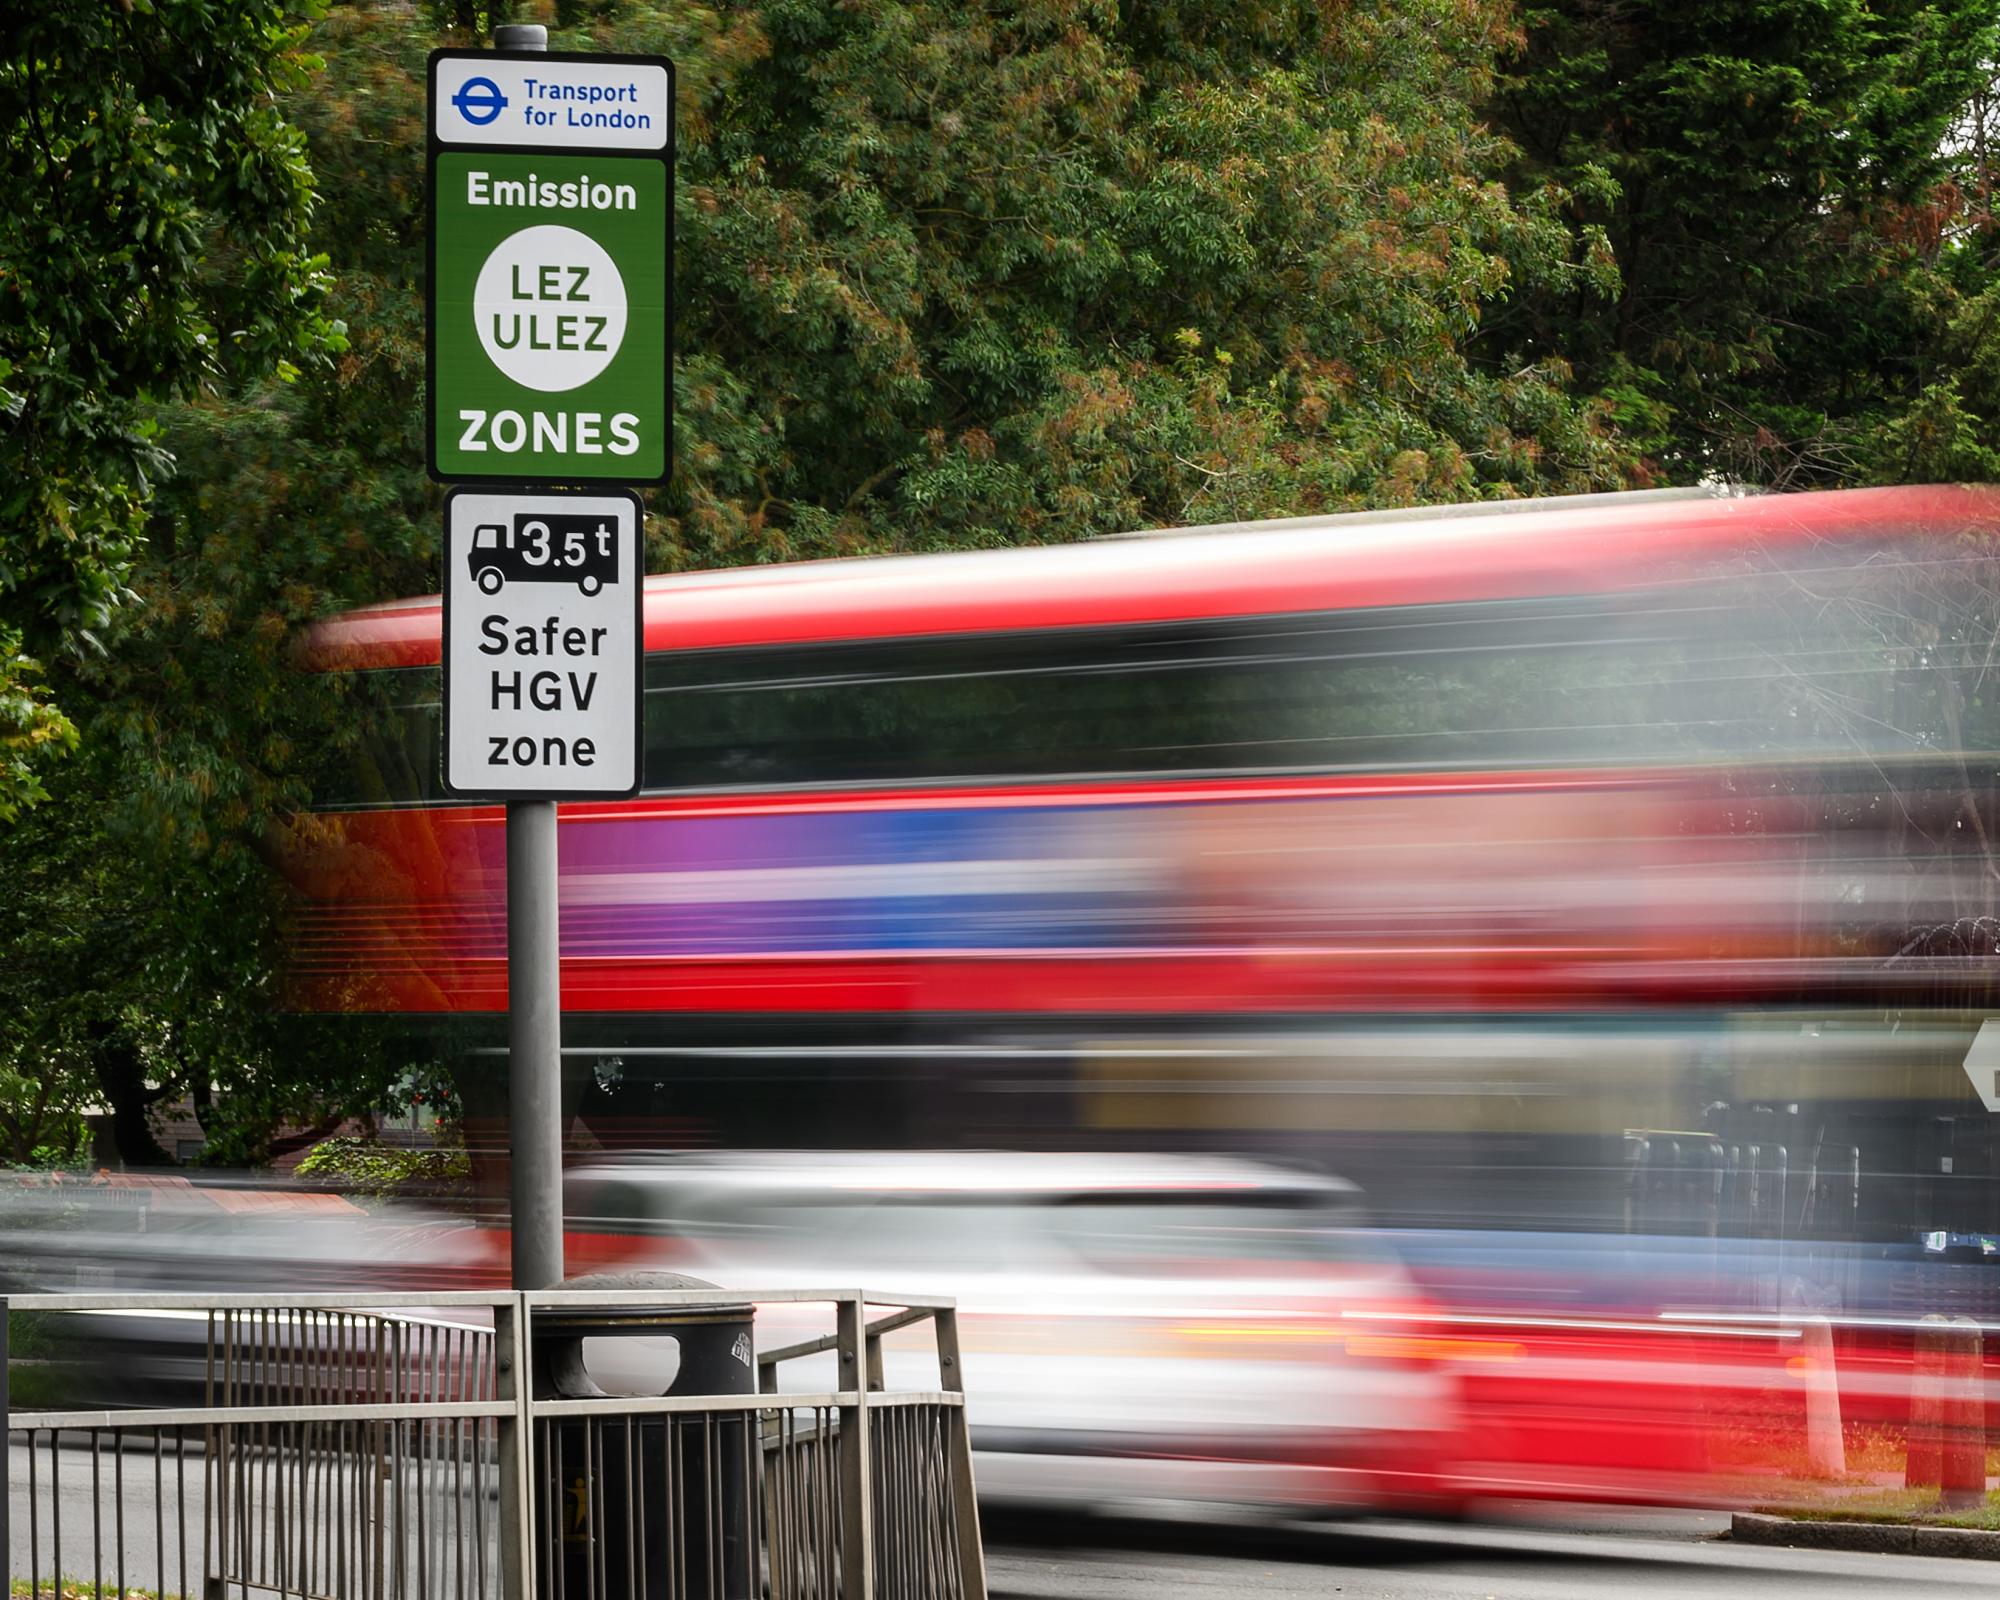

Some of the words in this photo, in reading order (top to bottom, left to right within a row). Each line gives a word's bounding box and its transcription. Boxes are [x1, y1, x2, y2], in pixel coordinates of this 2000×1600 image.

[524, 79, 637, 104] Transport
[525, 106, 557, 126] for
[568, 107, 650, 129] London
[467, 171, 636, 209] Emission
[512, 265, 590, 301] LEZ
[493, 314, 608, 352] ULEZ
[459, 410, 640, 456] ZONES
[478, 614, 607, 656] Safer
[491, 671, 598, 711] HGV
[488, 736, 596, 767] zone
